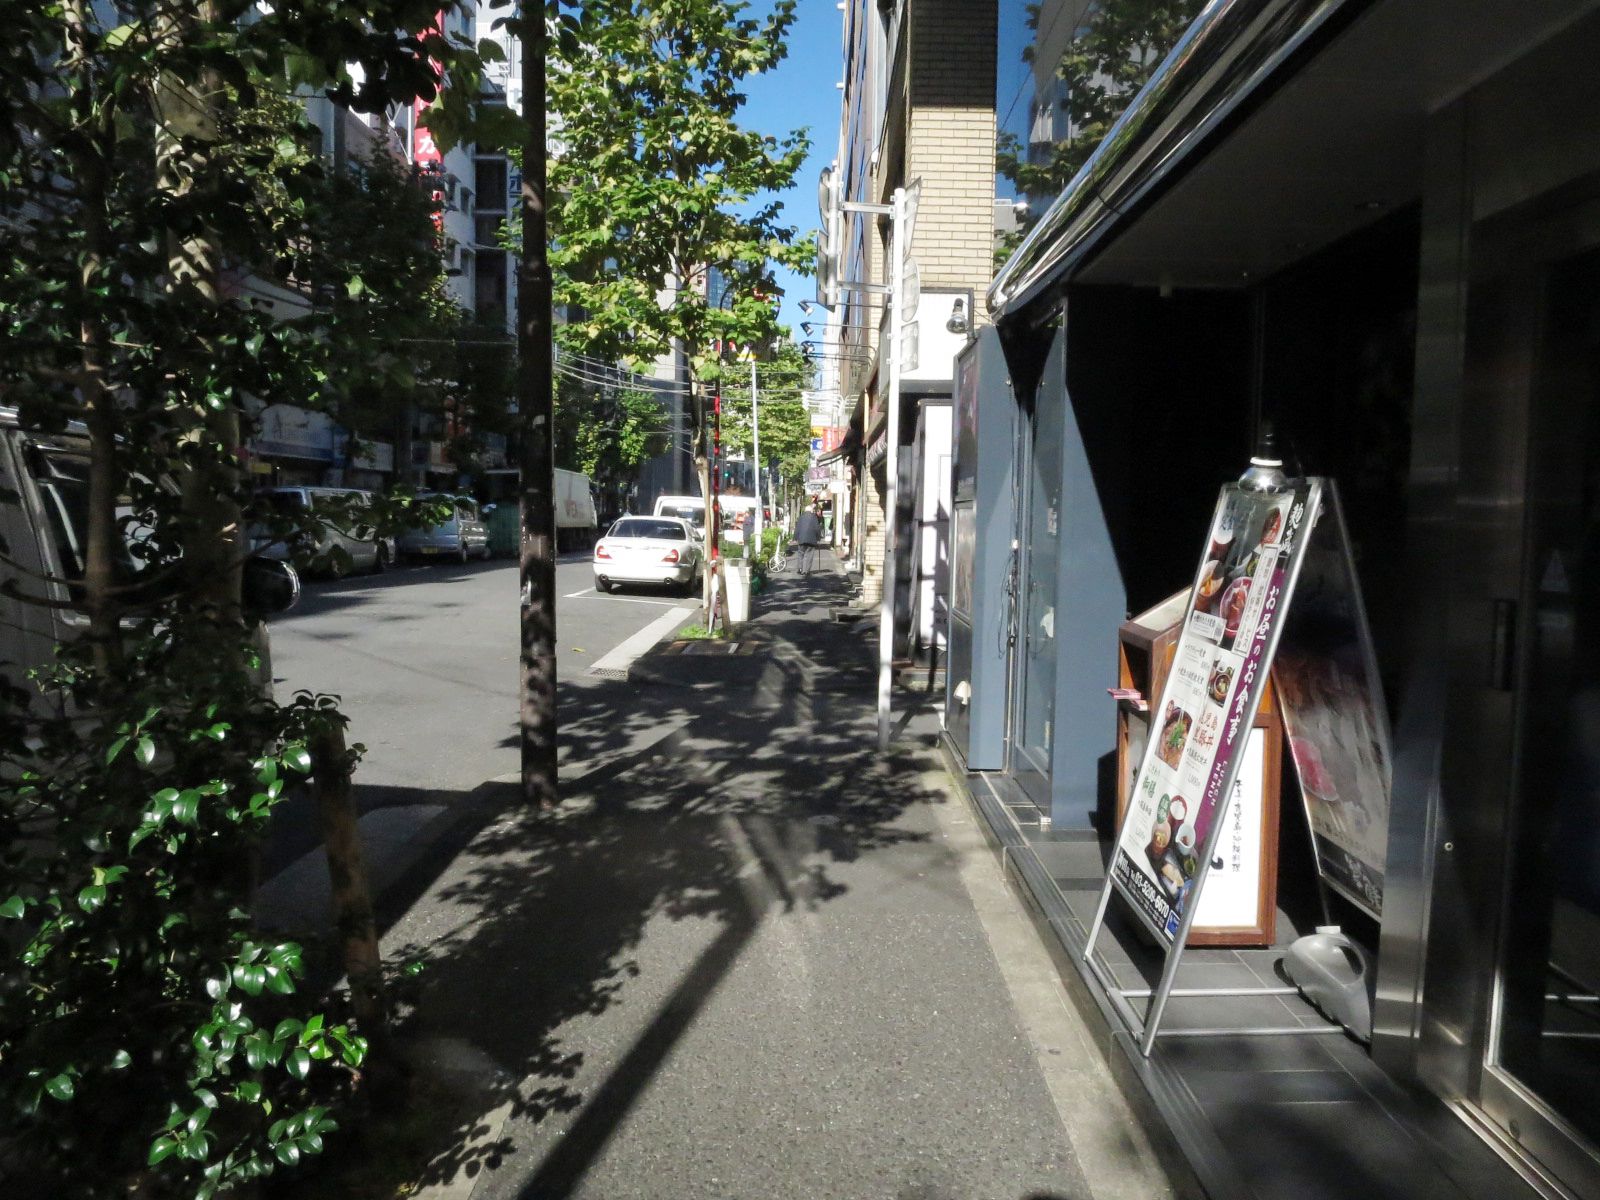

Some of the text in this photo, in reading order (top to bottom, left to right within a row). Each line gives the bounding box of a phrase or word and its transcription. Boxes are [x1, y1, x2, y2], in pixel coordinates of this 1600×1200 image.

[1226, 585, 1280, 746] お昼のお食事
[1207, 762, 1222, 799] MENU
[1211, 760, 1228, 806] LUNCH
